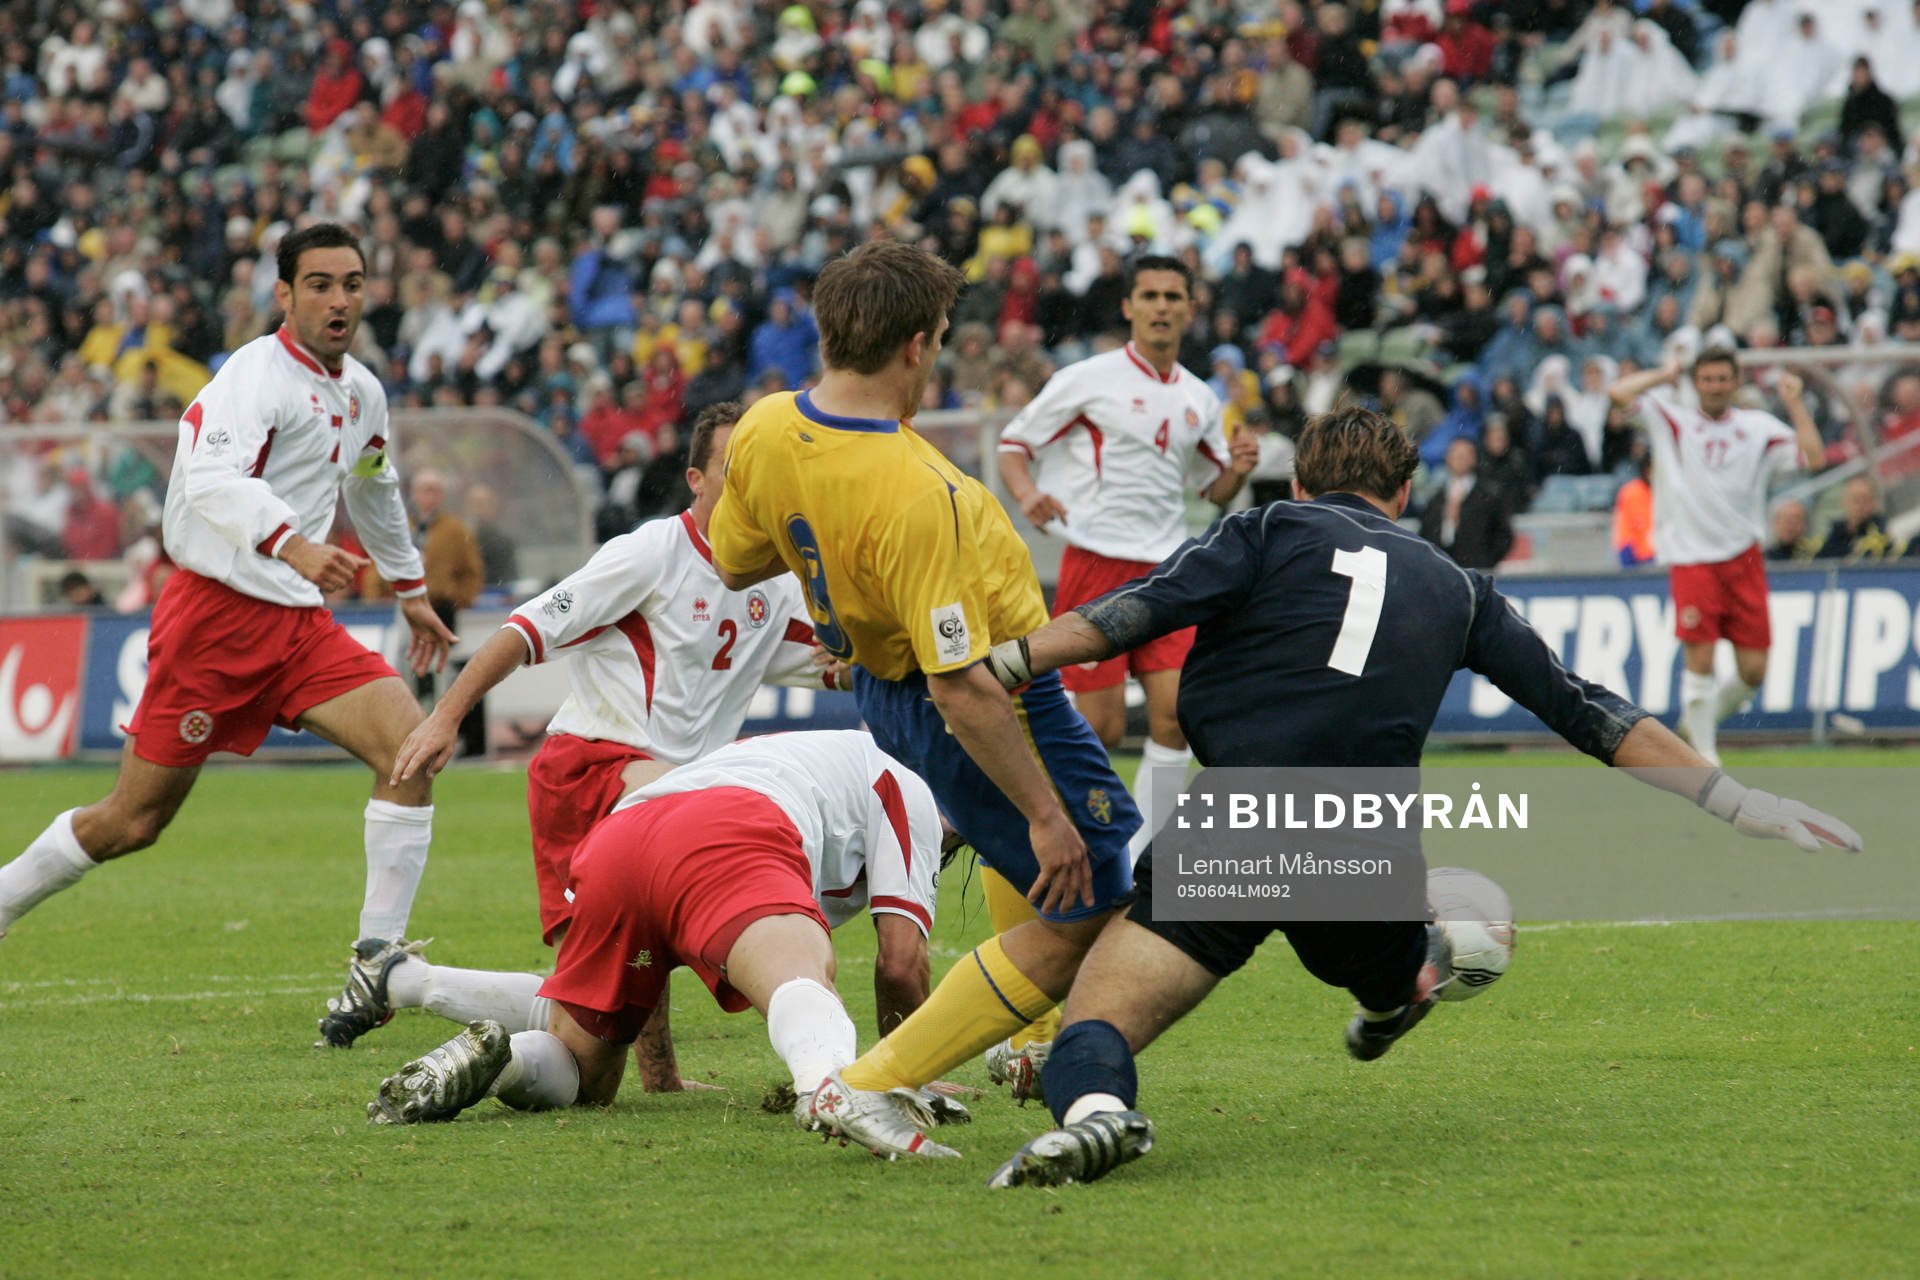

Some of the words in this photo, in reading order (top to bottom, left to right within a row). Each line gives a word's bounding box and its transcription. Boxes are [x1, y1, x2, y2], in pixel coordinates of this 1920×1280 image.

[329, 414, 344, 465] 7
[1154, 417, 1169, 454] 4
[1327, 545, 1388, 677] 1
[711, 618, 738, 671] 2
